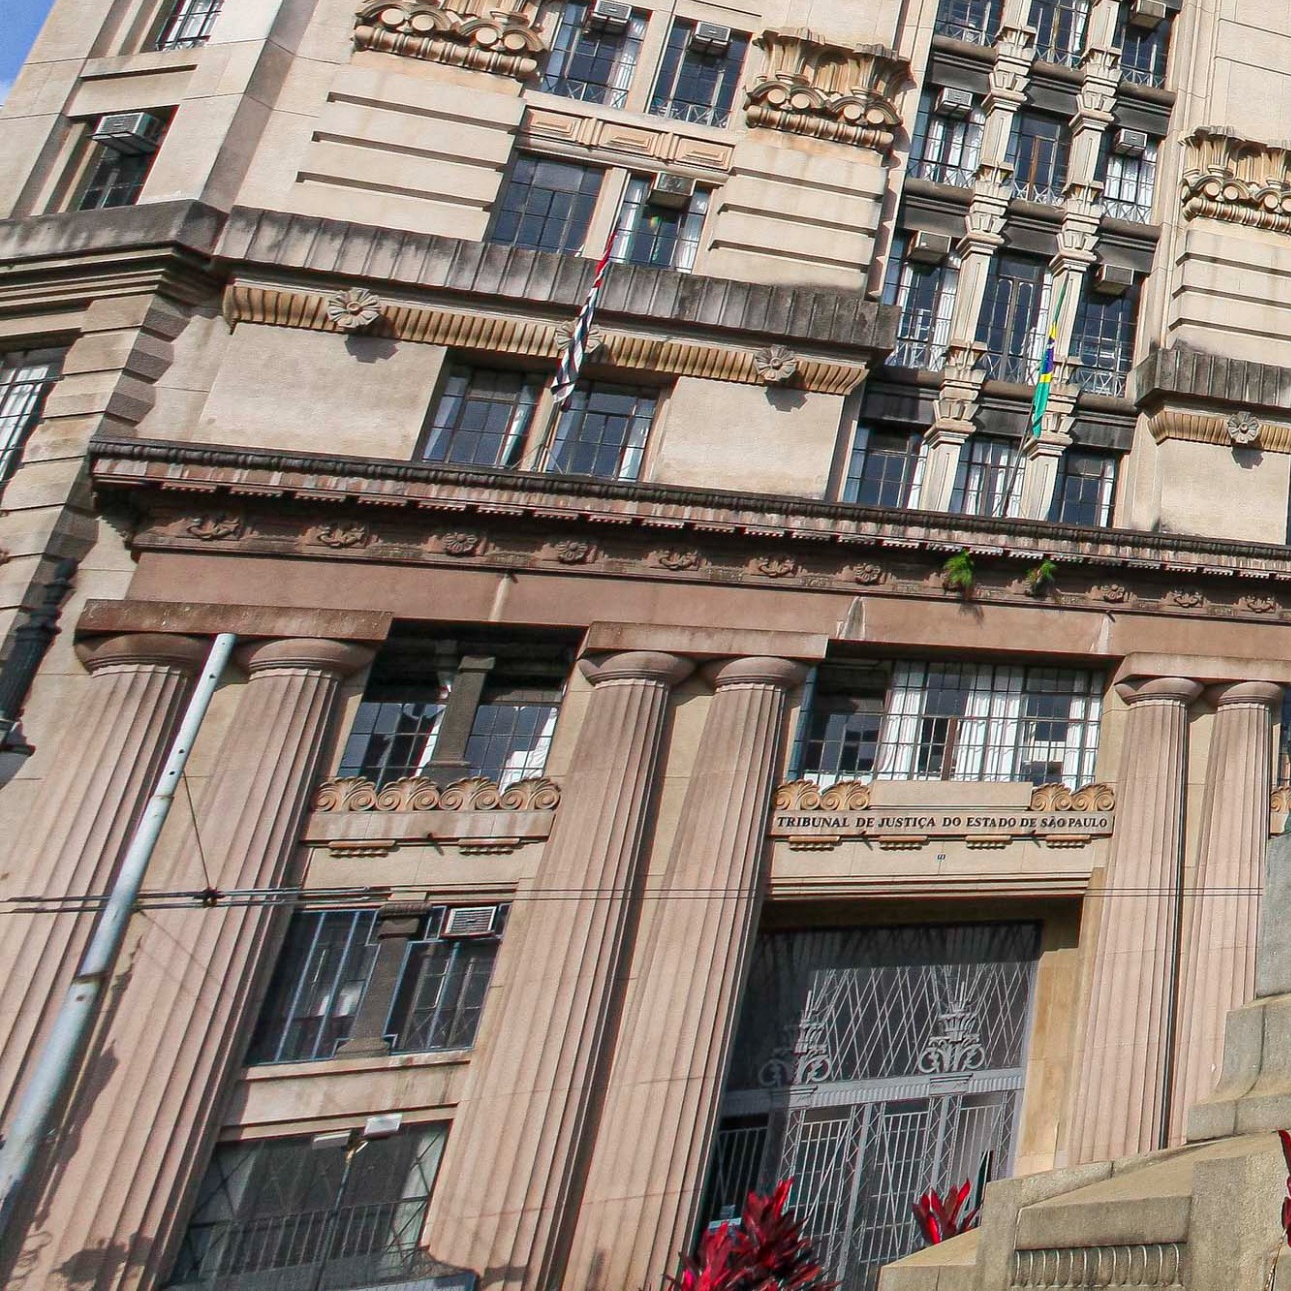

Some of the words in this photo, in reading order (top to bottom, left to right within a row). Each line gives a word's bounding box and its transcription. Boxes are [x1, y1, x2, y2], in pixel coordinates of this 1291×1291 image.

[777, 816, 850, 828] TRIBUNAL
[855, 817, 875, 828] DE
[877, 816, 936, 829] JUSTIÇA
[942, 817, 962, 827] DO
[966, 817, 1017, 828] ESTADO
[1018, 817, 1037, 828] DE
[1040, 815, 1067, 828] SÃO
[1067, 817, 1108, 828] PAULO
